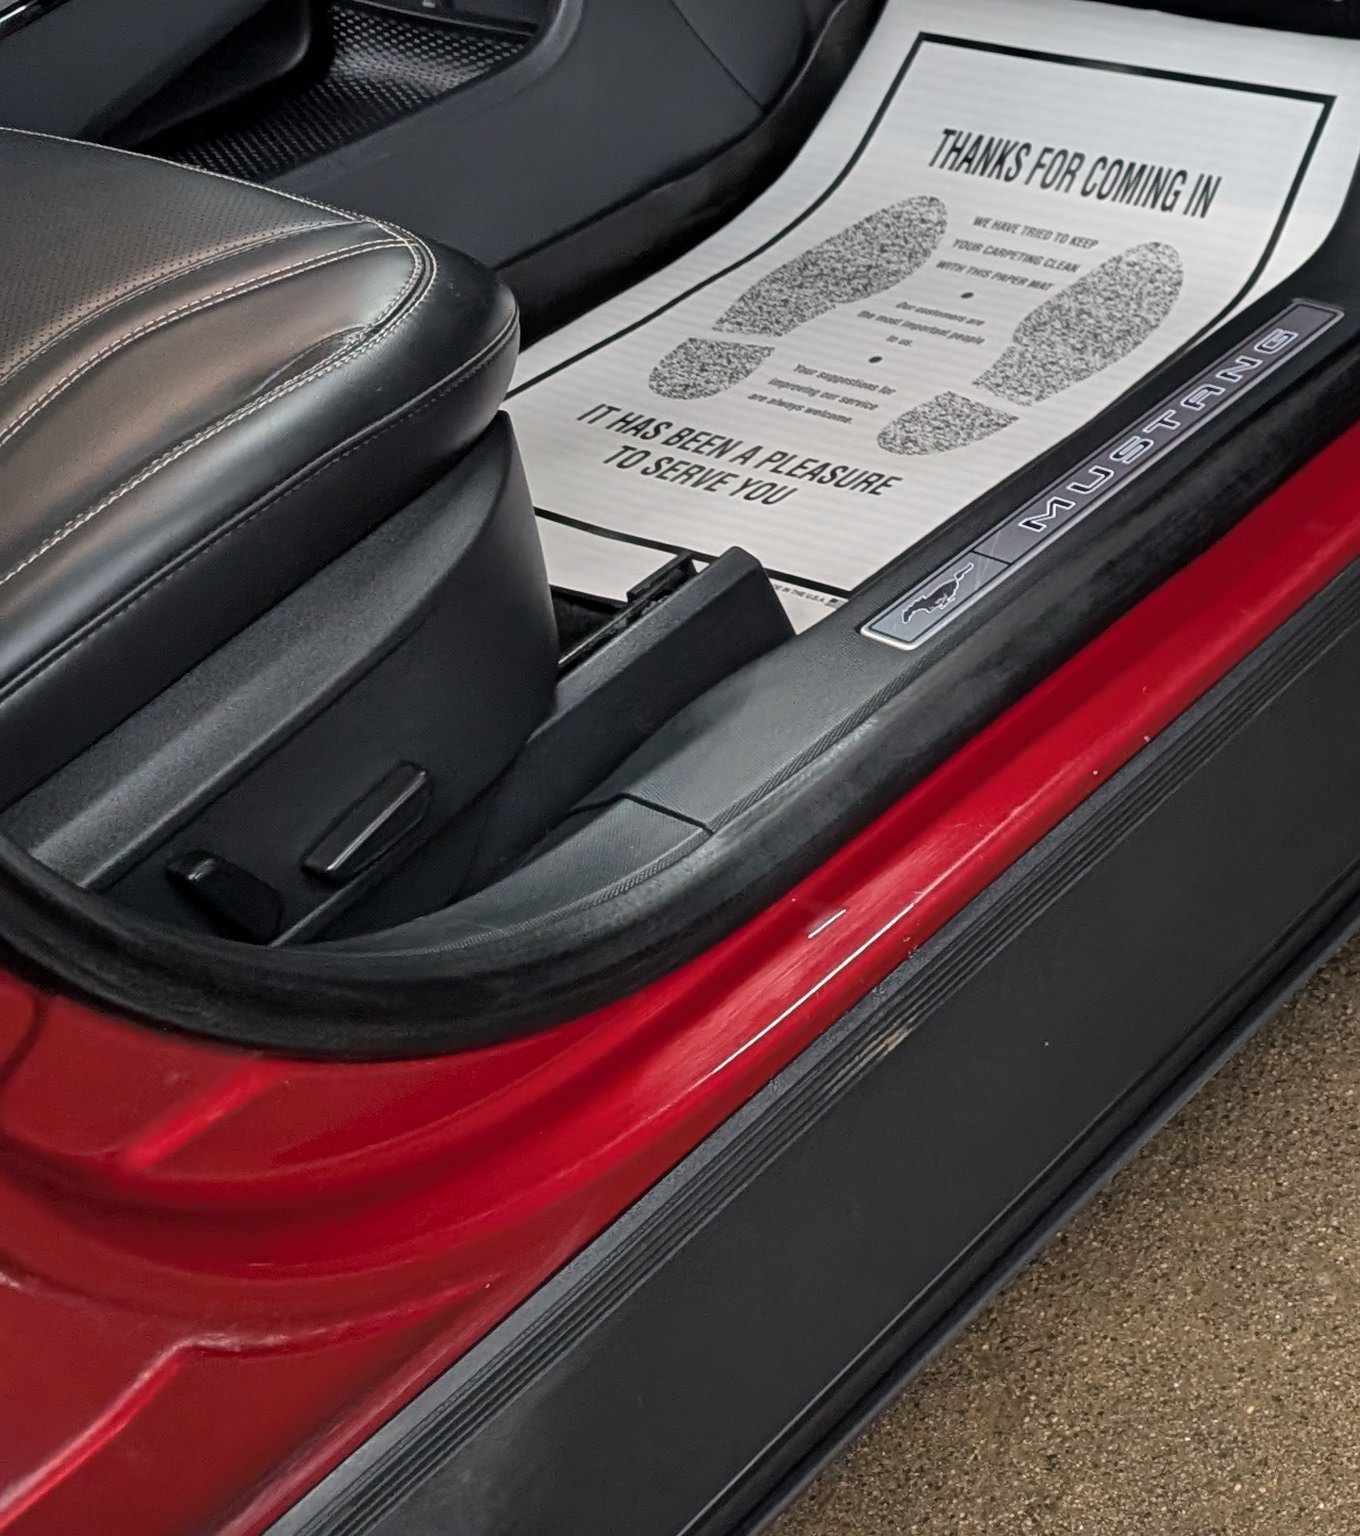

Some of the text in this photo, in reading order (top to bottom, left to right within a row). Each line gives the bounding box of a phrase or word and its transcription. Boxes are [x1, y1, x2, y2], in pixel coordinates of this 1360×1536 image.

[929, 128, 1222, 218] THANKS FOR COMING IN
[973, 216, 1099, 249] WE HAVE TRIED TO KEEP
[952, 238, 1080, 273] YOUR CARPETING CLEAN
[936, 260, 1055, 292] WITH THIS PAPER MAT
[857, 310, 985, 345] the most important people
[895, 301, 985, 326] Our customers are
[886, 335, 899, 343] to
[767, 377, 879, 411] improving our service
[793, 364, 897, 395] Your suggestions for
[747, 393, 768, 402] are
[766, 398, 805, 411] always
[1018, 328, 1299, 532] MUSTANG
[576, 403, 903, 496] IT HAS BEEN A PLEASURE
[602, 445, 798, 505] TO SERVE YOU
